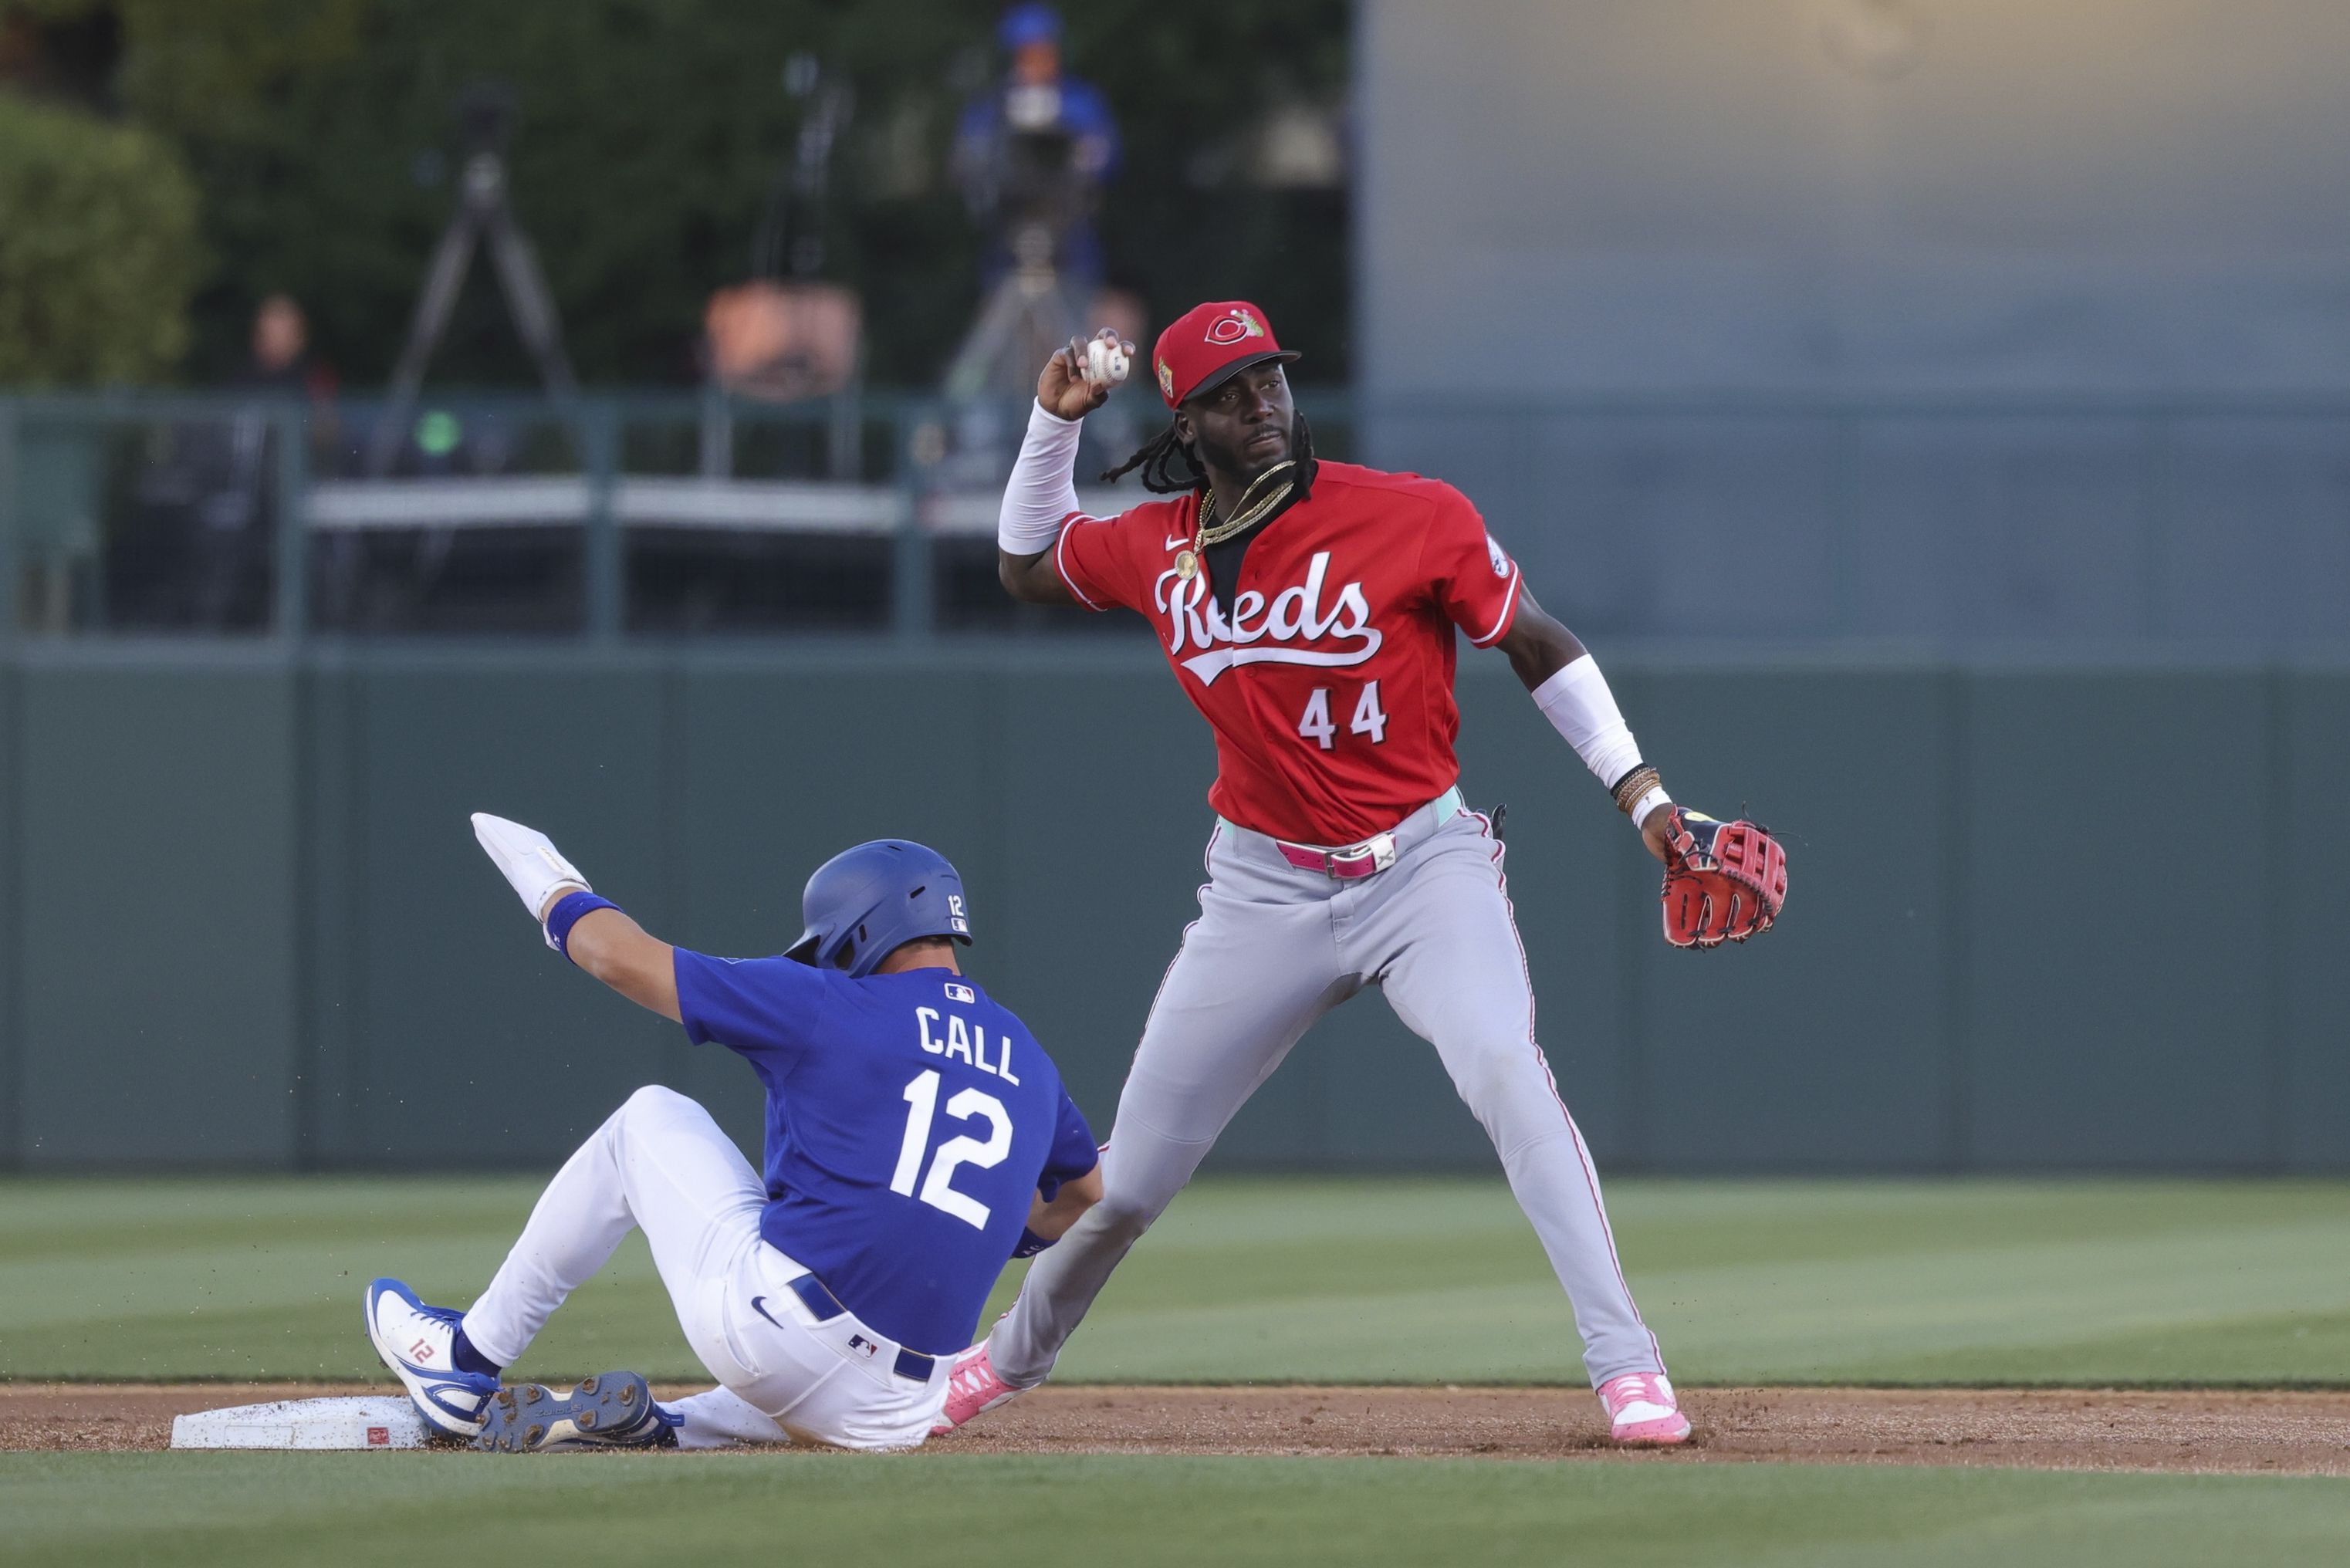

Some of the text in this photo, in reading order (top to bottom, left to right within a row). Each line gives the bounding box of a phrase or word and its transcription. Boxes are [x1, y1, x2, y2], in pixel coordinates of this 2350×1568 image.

[1298, 673, 1386, 749] 44
[948, 894, 964, 917] 12
[916, 1006, 1019, 1086] CALL
[889, 1069, 1013, 1231] 12
[409, 1338, 434, 1364] 12
